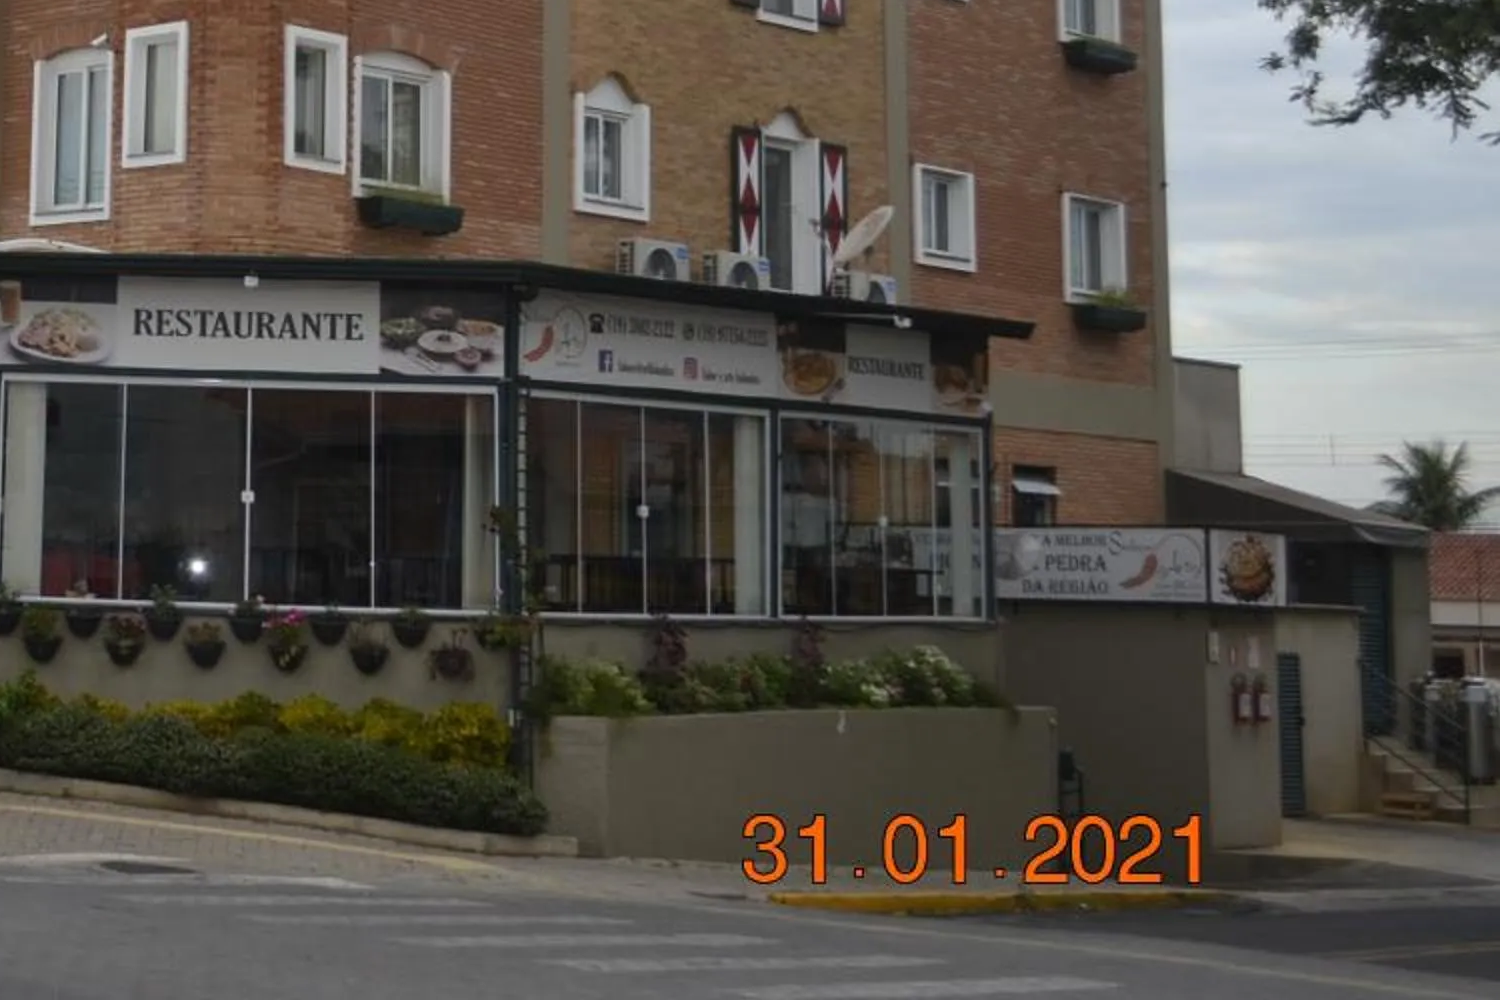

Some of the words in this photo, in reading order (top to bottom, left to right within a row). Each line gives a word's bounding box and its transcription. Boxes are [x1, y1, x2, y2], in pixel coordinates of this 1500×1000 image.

[132, 308, 364, 341] RESTAURANTE
[848, 356, 926, 380] RESTAURANTE
[1045, 553, 1107, 573] PEDRA
[1022, 579, 1045, 594] DA
